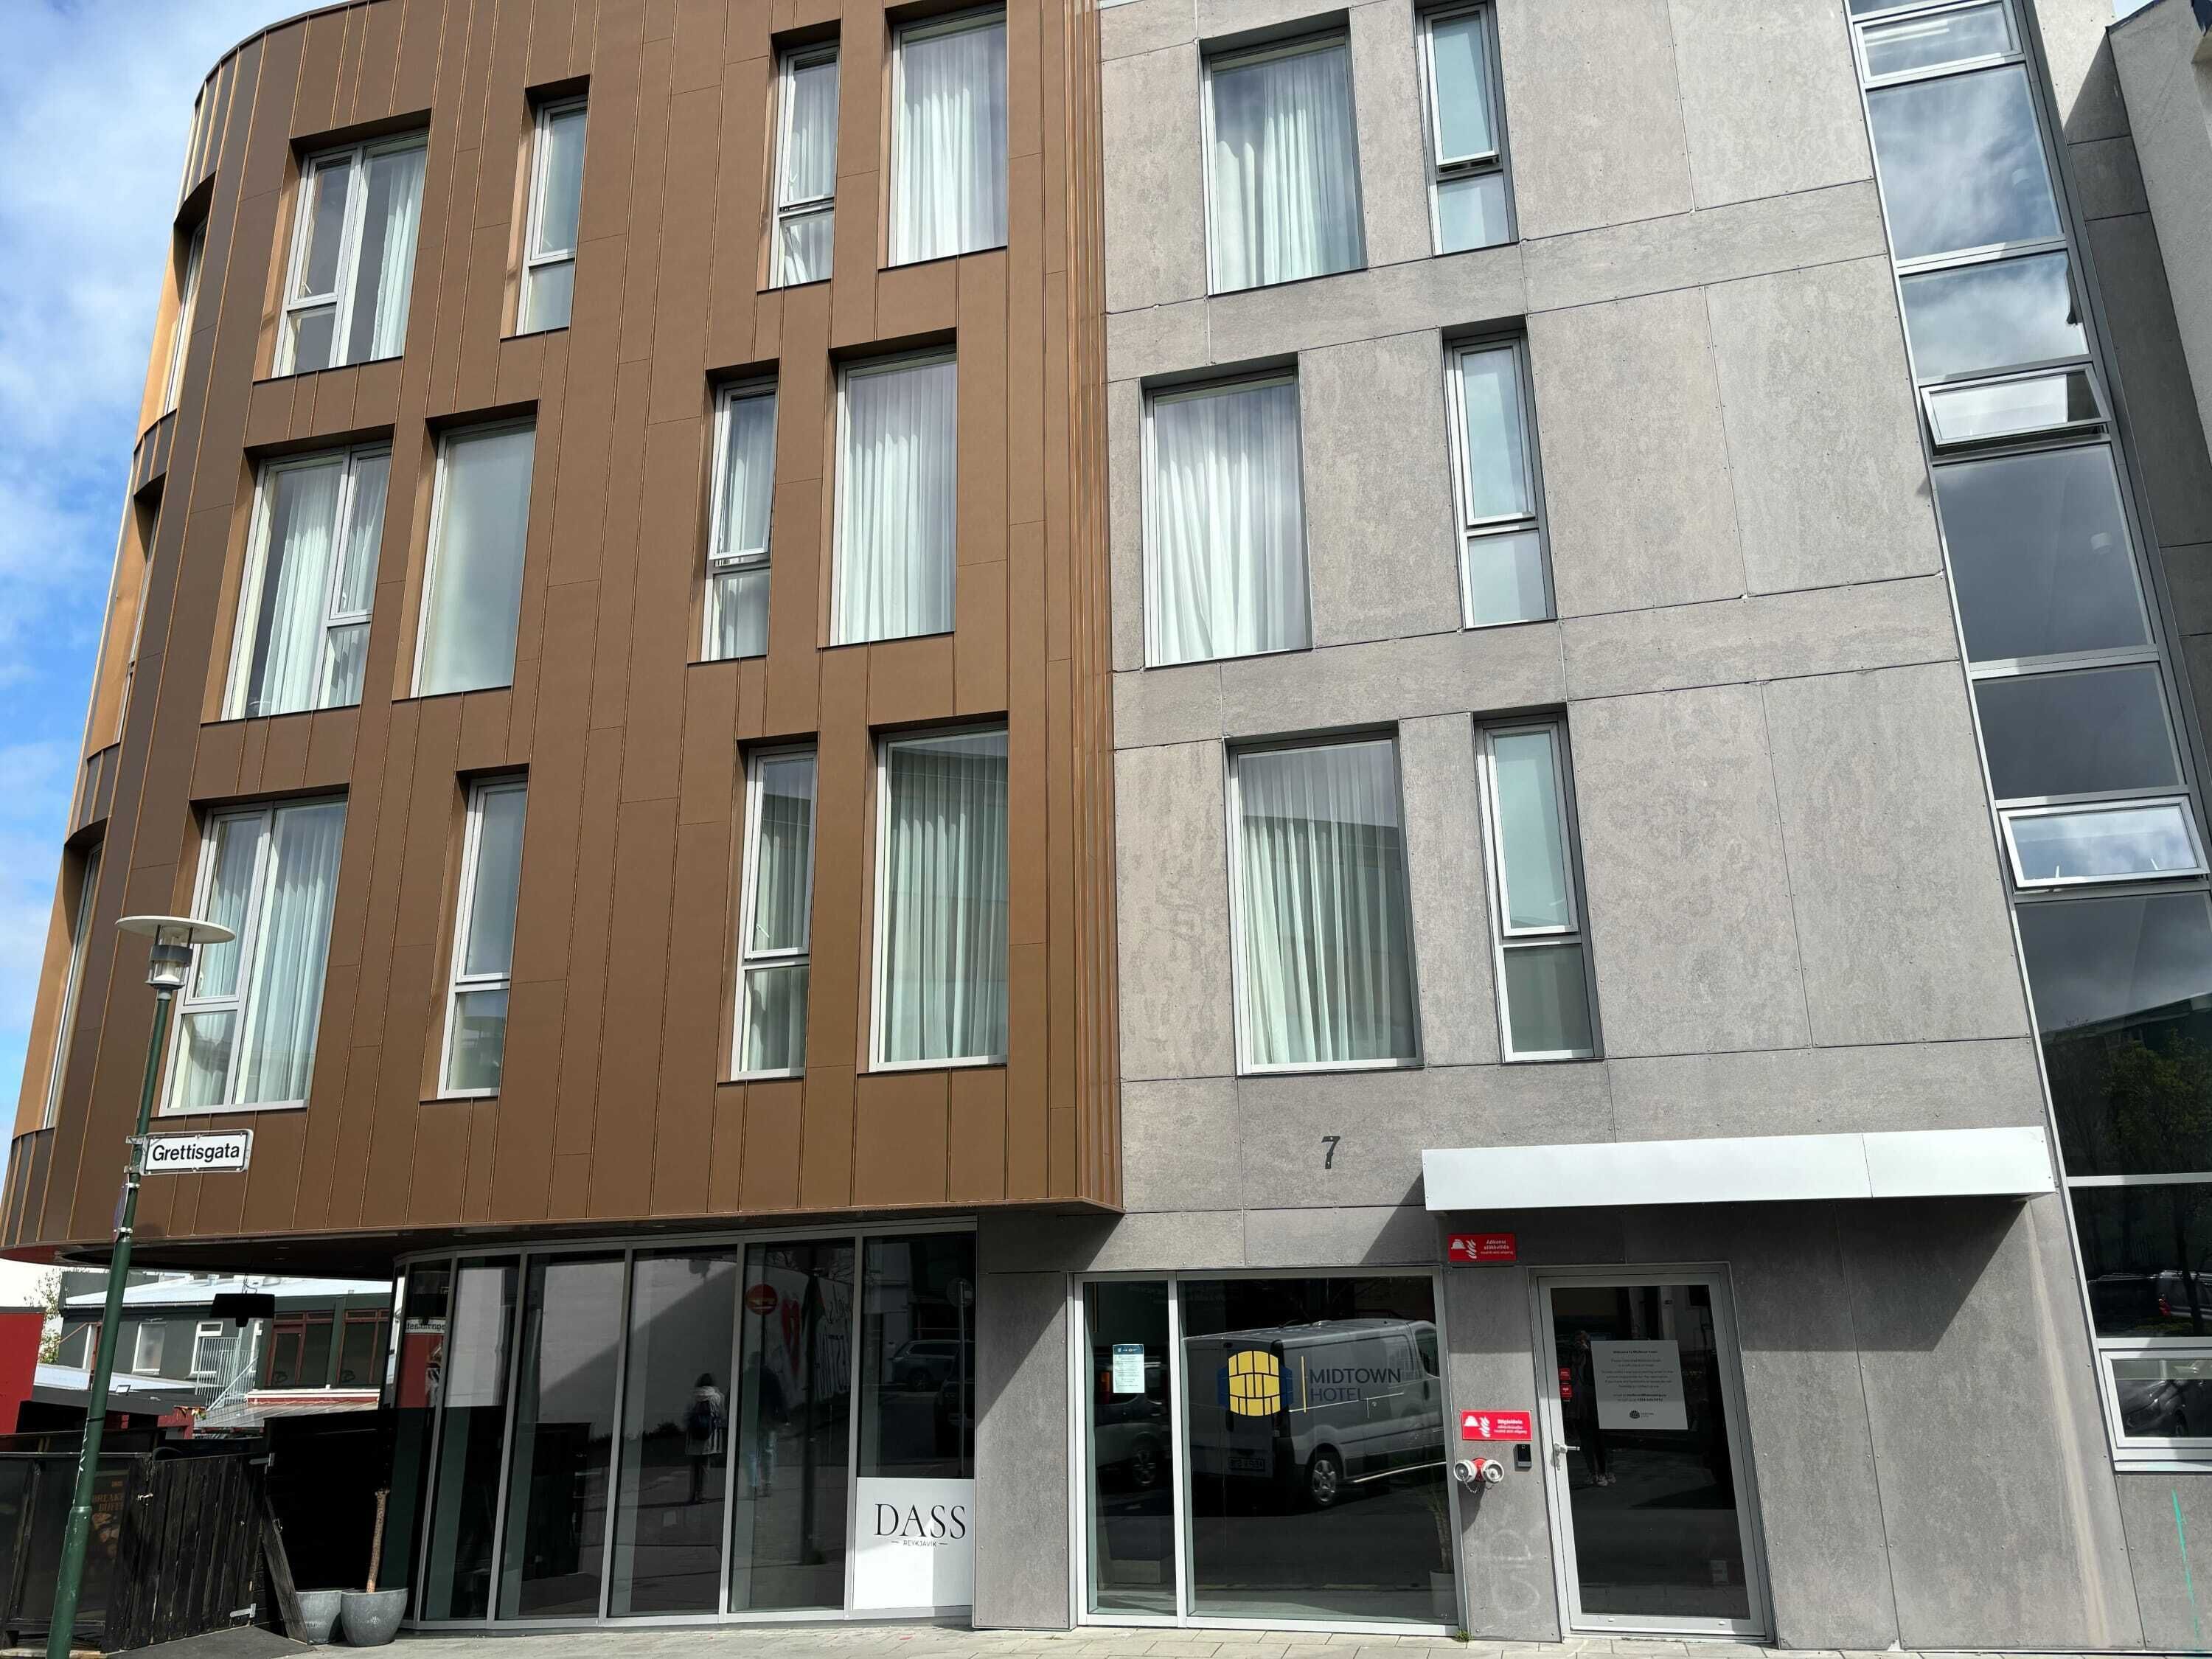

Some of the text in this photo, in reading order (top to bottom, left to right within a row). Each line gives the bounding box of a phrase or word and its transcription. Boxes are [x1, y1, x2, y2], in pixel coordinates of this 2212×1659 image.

[152, 1143, 240, 1163] Grettisgata
[1321, 1135, 1340, 1169] 7
[1309, 1368, 1401, 1384] MIDTOWN
[1310, 1387, 1362, 1401] HOTEL
[874, 1503, 966, 1540] DASS
